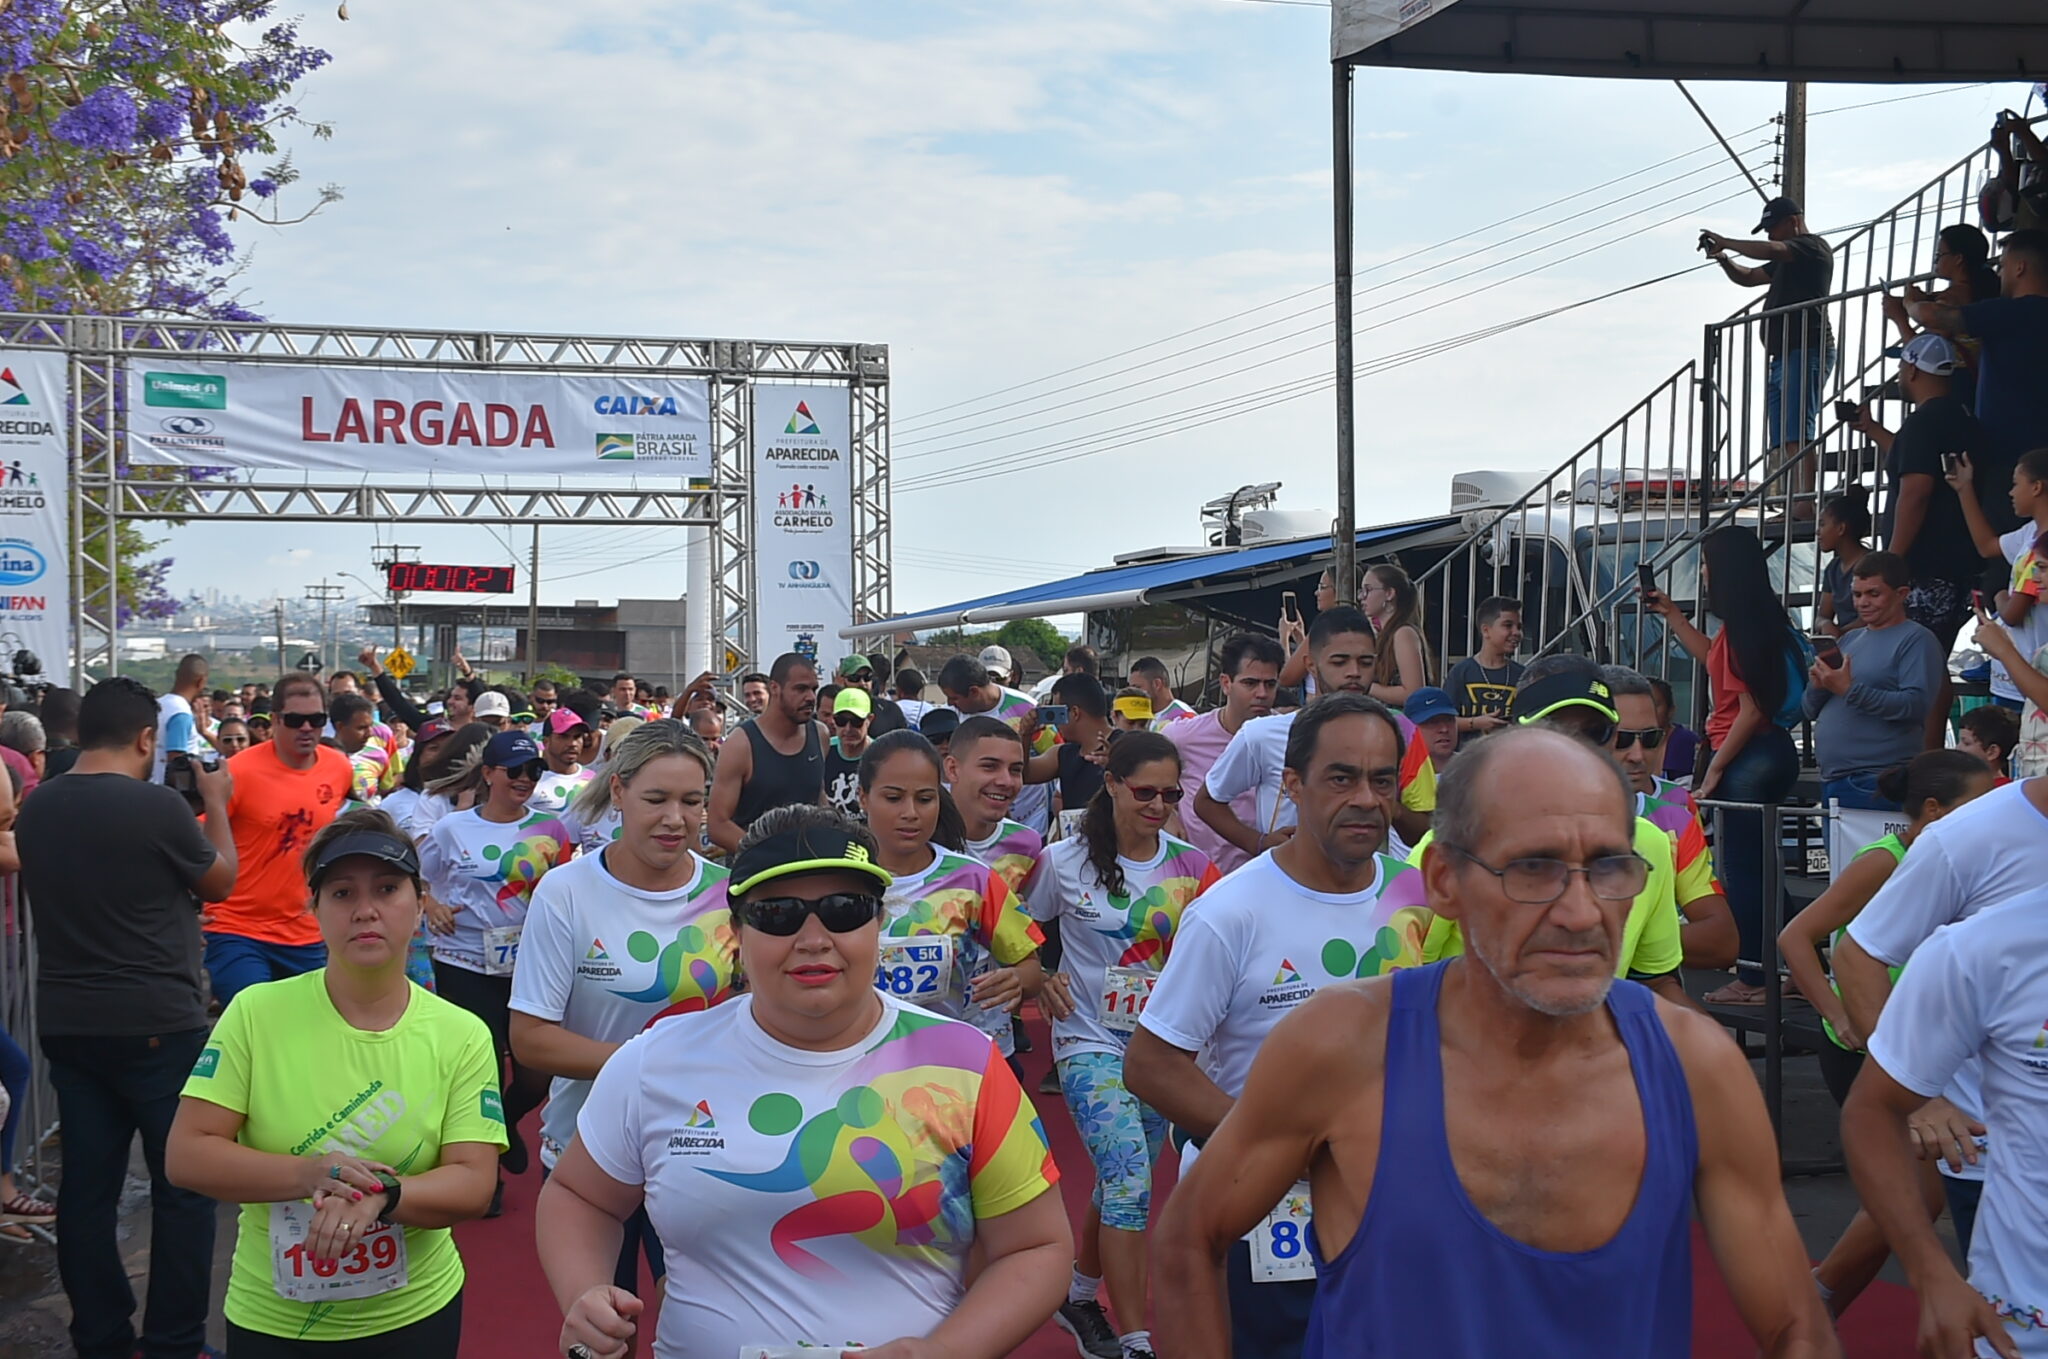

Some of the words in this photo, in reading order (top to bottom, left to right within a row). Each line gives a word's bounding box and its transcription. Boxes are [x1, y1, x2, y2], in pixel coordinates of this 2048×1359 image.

[152, 381, 201, 392] Unimed
[594, 396, 677, 416] CAIXA
[302, 396, 555, 449] LARGADA
[636, 432, 664, 441] PÁTRIA
[636, 442, 698, 456] BRASIL
[765, 447, 840, 461] APARECIDA
[773, 516, 834, 528] CARMELO
[1884, 822, 1910, 835] PODE
[918, 949, 938, 961] 5K
[873, 964, 939, 994] 482
[290, 1126, 327, 1156] Corrida
[326, 1121, 334, 1129] e
[332, 1080, 382, 1123] Caminhada
[667, 1136, 725, 1149] APARECIDA
